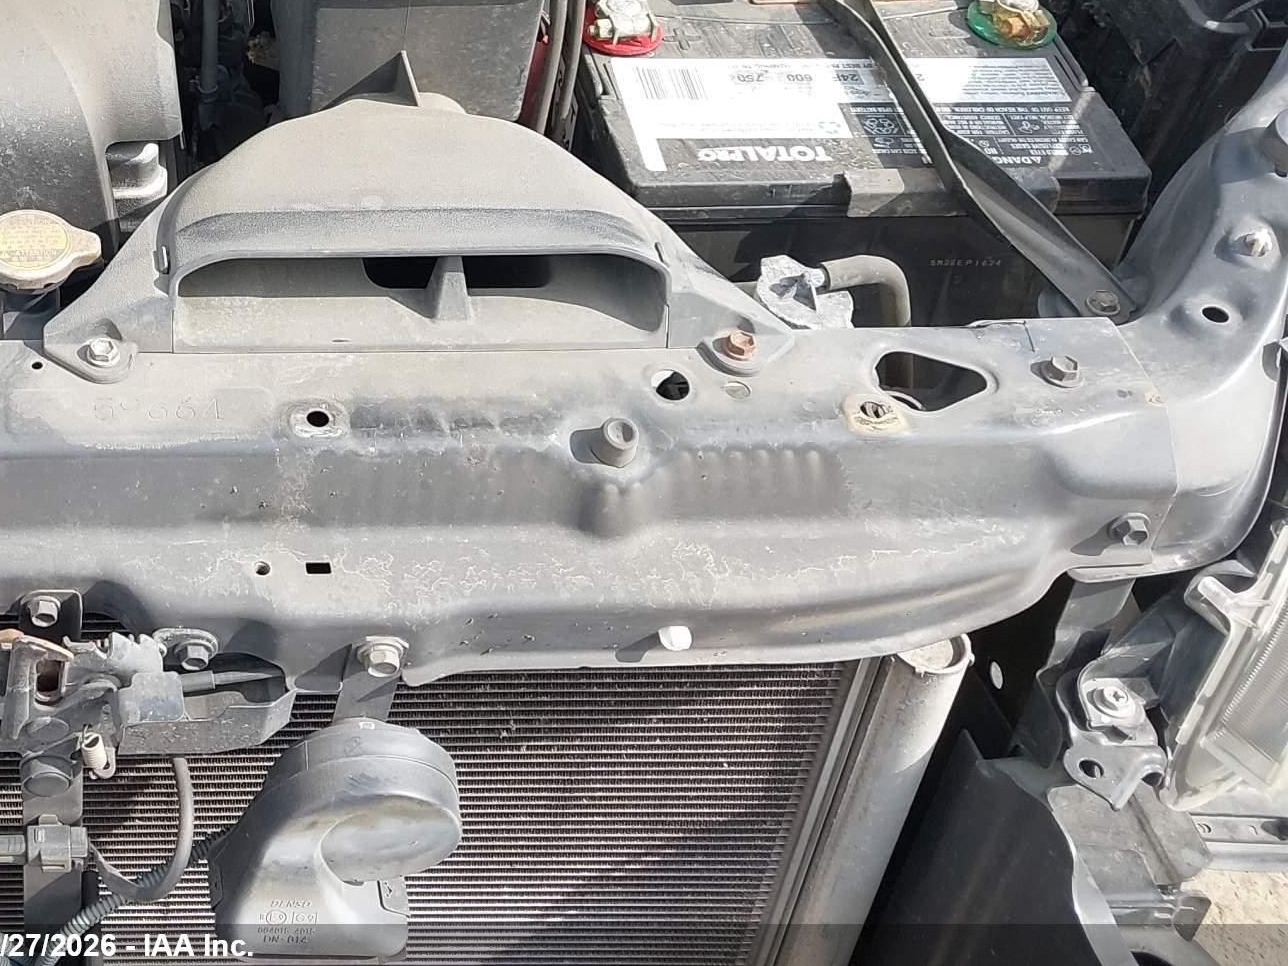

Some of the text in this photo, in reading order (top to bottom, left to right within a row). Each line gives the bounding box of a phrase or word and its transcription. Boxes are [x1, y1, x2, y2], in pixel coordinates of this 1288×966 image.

[786, 73, 813, 82] 600
[696, 145, 833, 163] TOTALPRO
[990, 155, 1032, 165] DANG
[270, 899, 312, 908] DENSO
